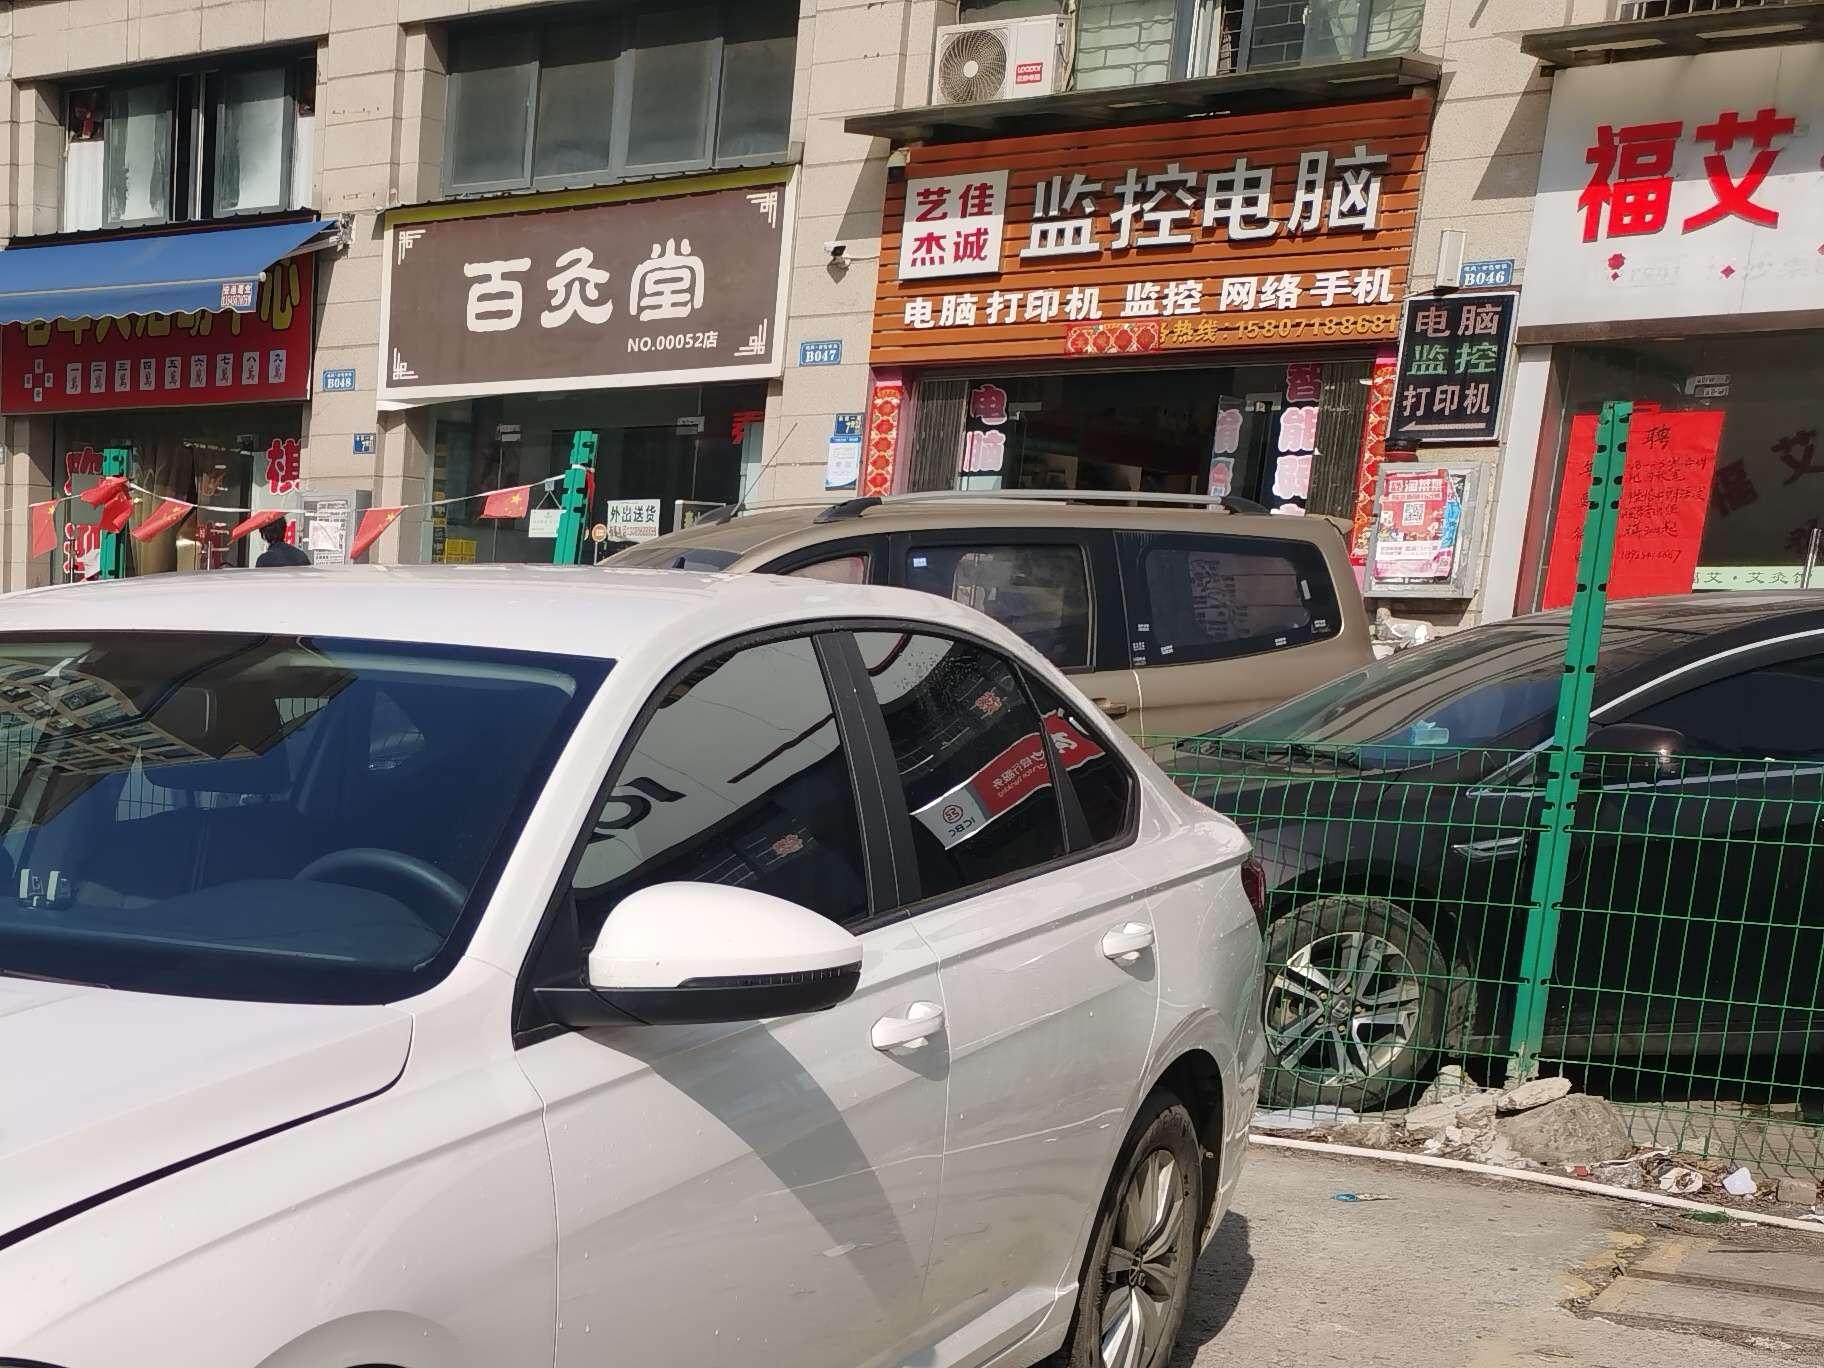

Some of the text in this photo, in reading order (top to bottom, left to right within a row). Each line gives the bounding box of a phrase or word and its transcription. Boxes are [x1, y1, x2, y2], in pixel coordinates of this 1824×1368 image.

[915, 181, 995, 223] 艺佳
[1019, 144, 1390, 260] 监控电脑
[910, 226, 990, 268] 杰诚
[464, 238, 705, 333] 百灸堂
[1464, 271, 1505, 286] B046
[904, 269, 1395, 330] 电脑 打印机 监控 网络 手机
[1416, 304, 1501, 338] 电脑
[627, 331, 718, 353] NO.00052店
[805, 350, 837, 363] B047
[1406, 342, 1497, 376] 监控
[327, 377, 352, 389] B048
[1402, 382, 1491, 416] 打印机
[610, 504, 656, 523] 外出送货
